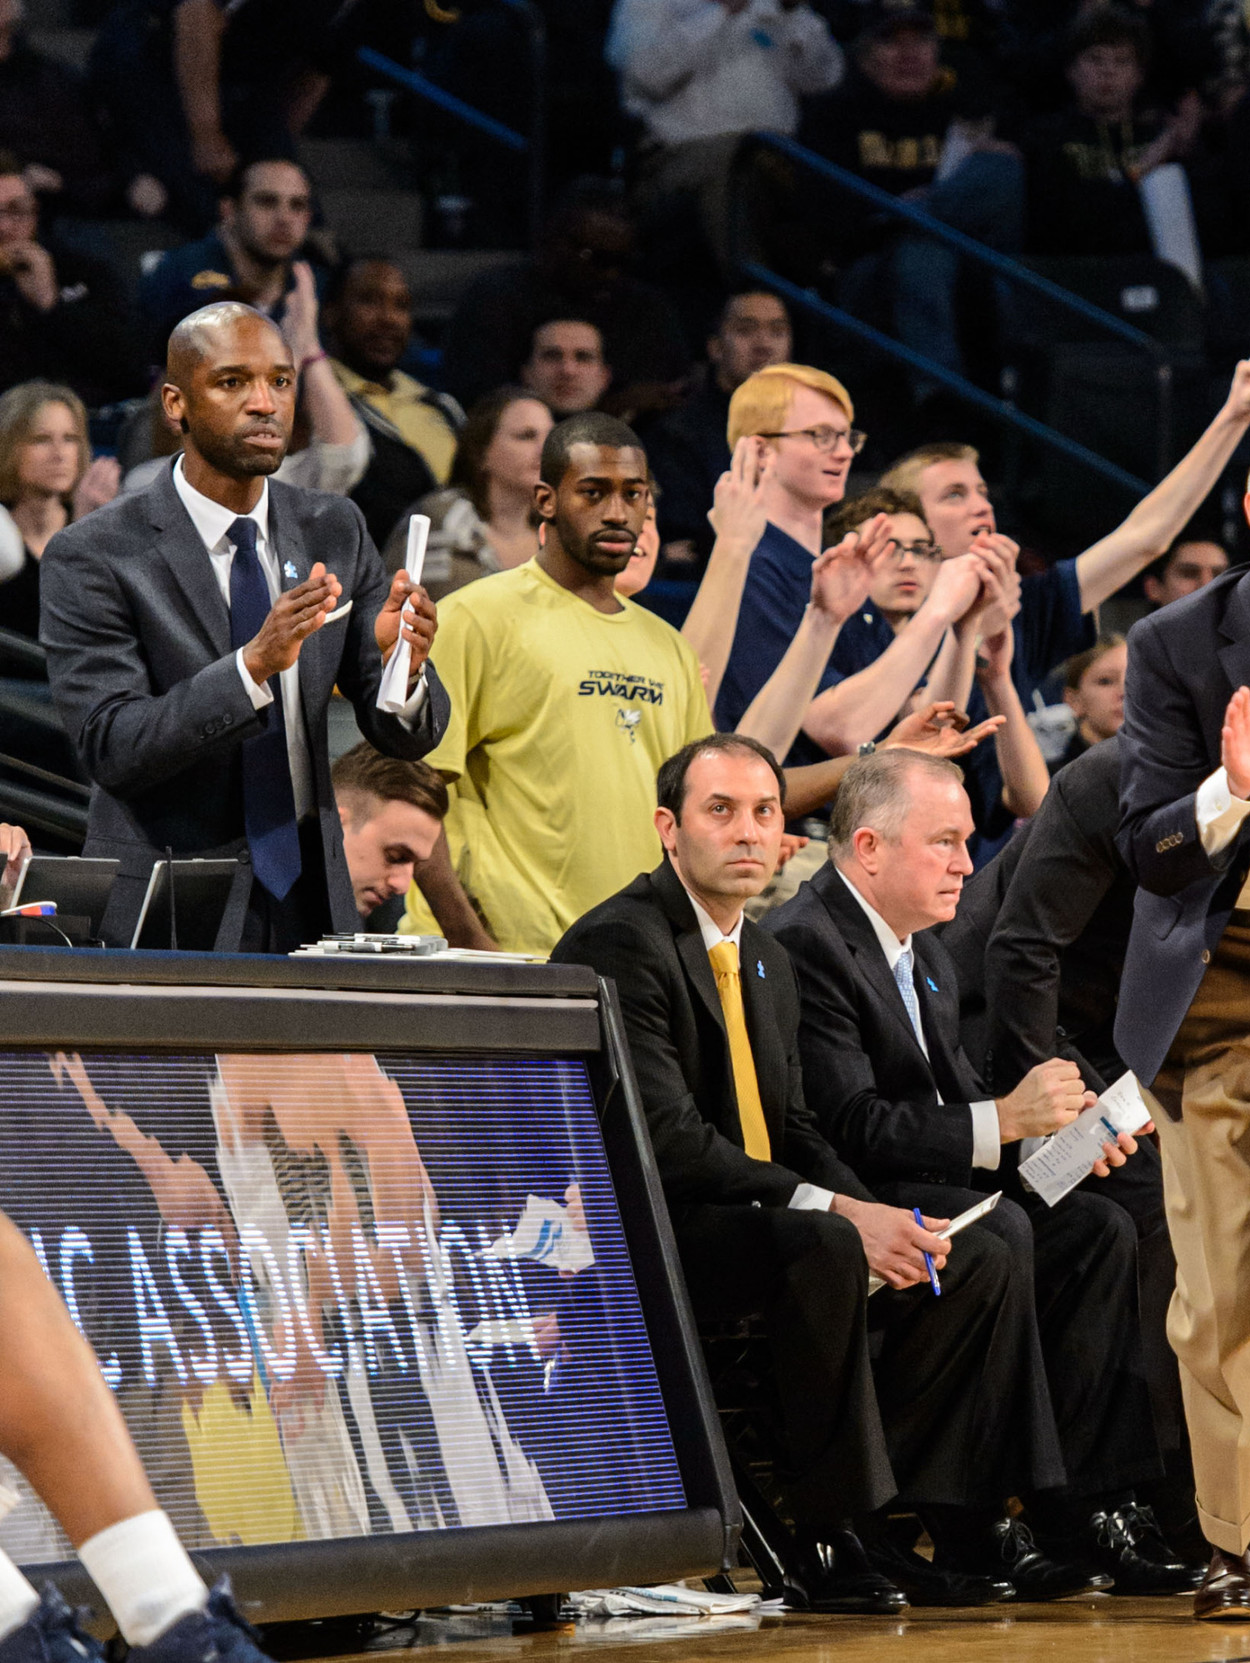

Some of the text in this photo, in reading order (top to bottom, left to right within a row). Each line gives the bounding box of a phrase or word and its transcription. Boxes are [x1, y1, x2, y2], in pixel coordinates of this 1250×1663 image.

[588, 670, 645, 684] TOGETHER
[578, 680, 663, 706] SWARM
[127, 1220, 542, 1386] ASSOCIATION
